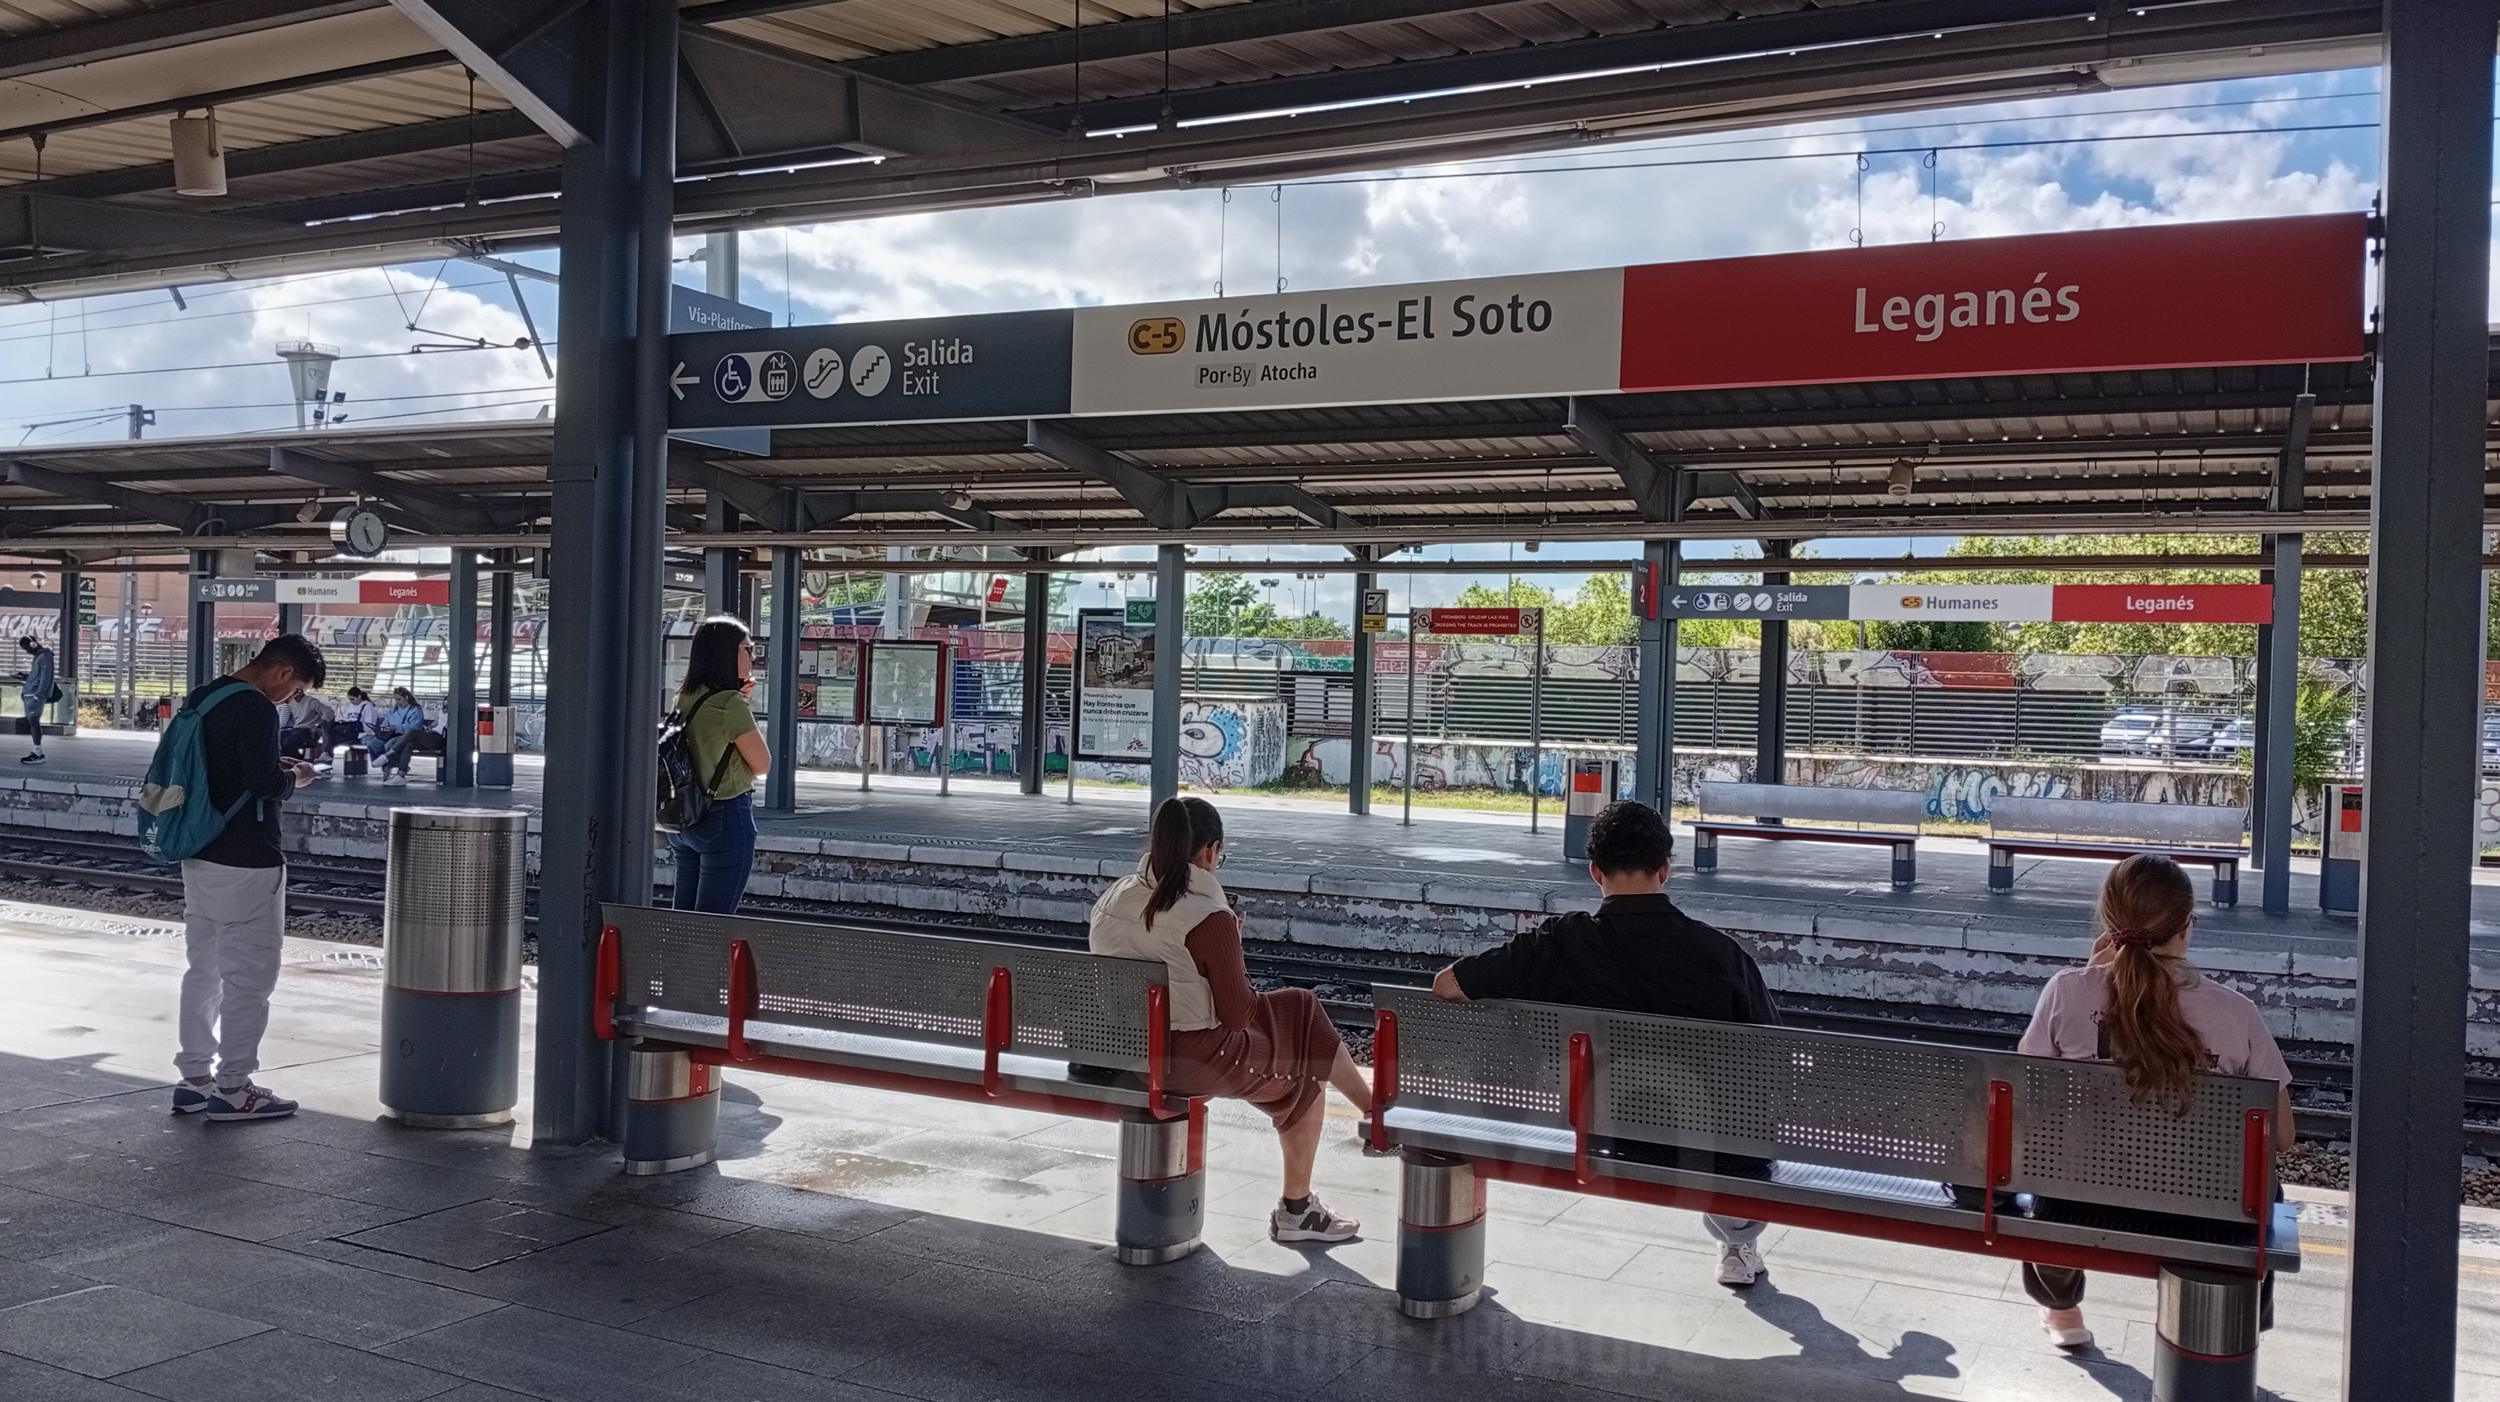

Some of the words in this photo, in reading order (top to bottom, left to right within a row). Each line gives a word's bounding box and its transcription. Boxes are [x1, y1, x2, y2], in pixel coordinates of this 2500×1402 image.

[1854, 271, 2080, 342] Leganés
[1195, 296, 1434, 353] Móstoles-El
[1452, 293, 1552, 338] Soto
[1132, 321, 1180, 350] C-5
[903, 338, 973, 367] Salida
[1260, 361, 1317, 382] Atocha
[903, 369, 940, 395] Exit
[307, 586, 338, 596] Humanes
[389, 586, 418, 598] Leganés
[1640, 584, 1645, 603] 2
[1776, 591, 1808, 603] Salida
[1776, 602, 1793, 612] Exit
[1901, 598, 1920, 608] C-5
[1926, 595, 1998, 610] Humanes
[2125, 595, 2194, 613] Leganés
[1083, 700, 1095, 708] Hay
